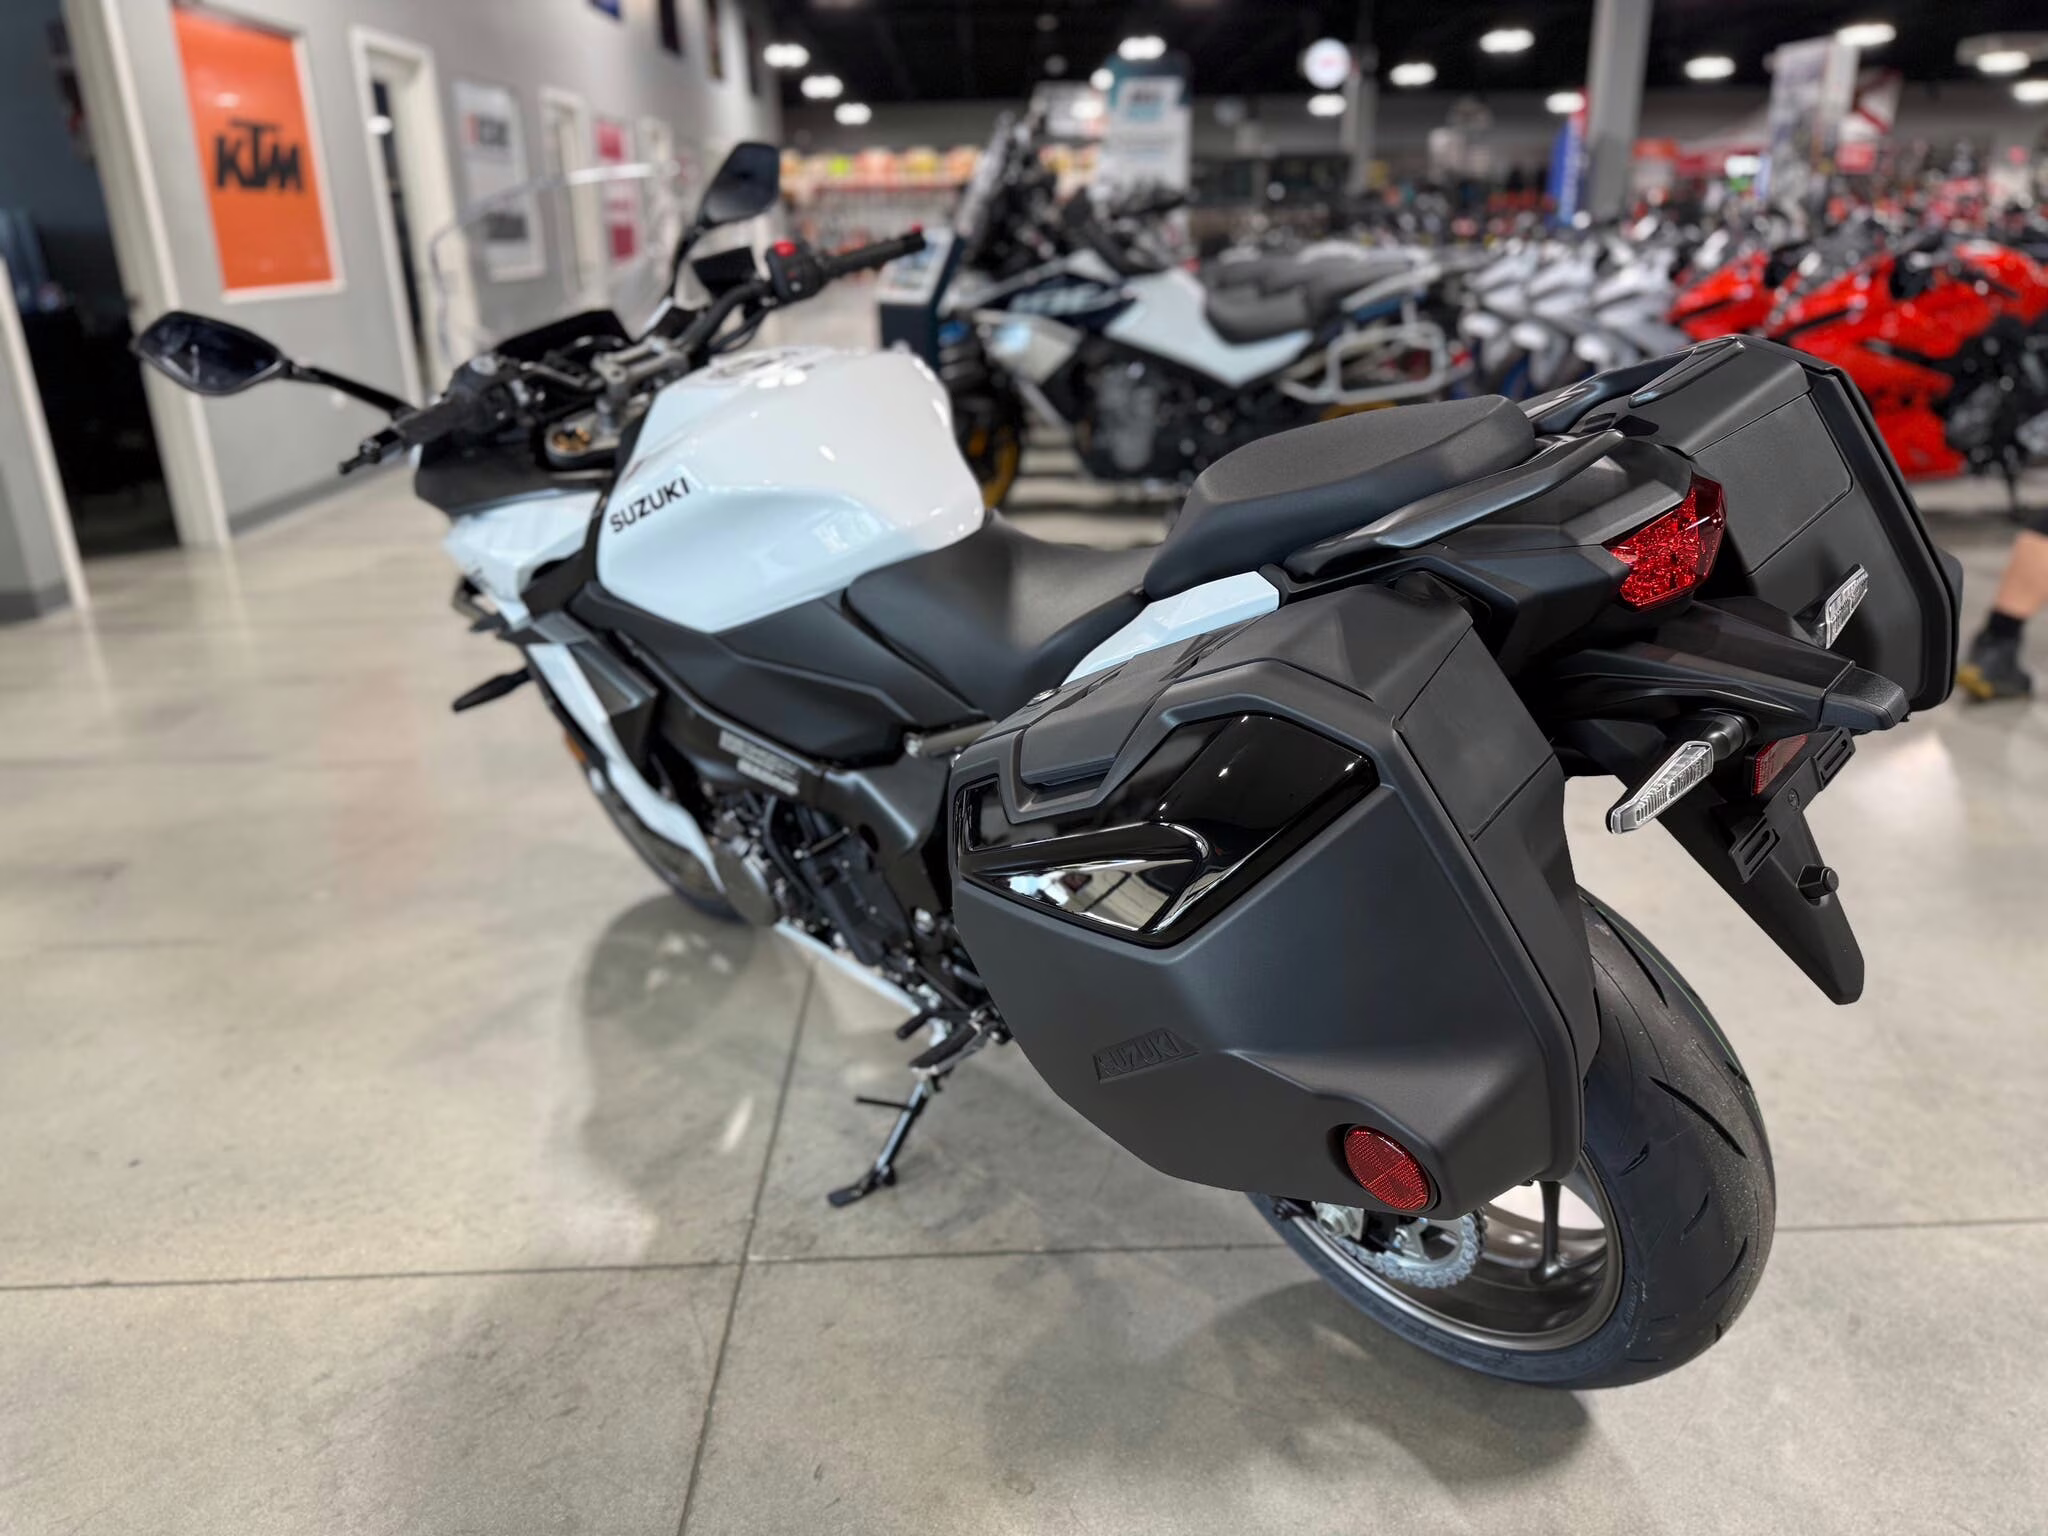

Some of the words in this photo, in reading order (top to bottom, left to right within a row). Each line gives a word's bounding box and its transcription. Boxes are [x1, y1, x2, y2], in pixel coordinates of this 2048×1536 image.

[216, 119, 304, 192] KTM
[610, 477, 690, 533] SUZUKI
[1097, 1030, 1183, 1078] SUZUKI
